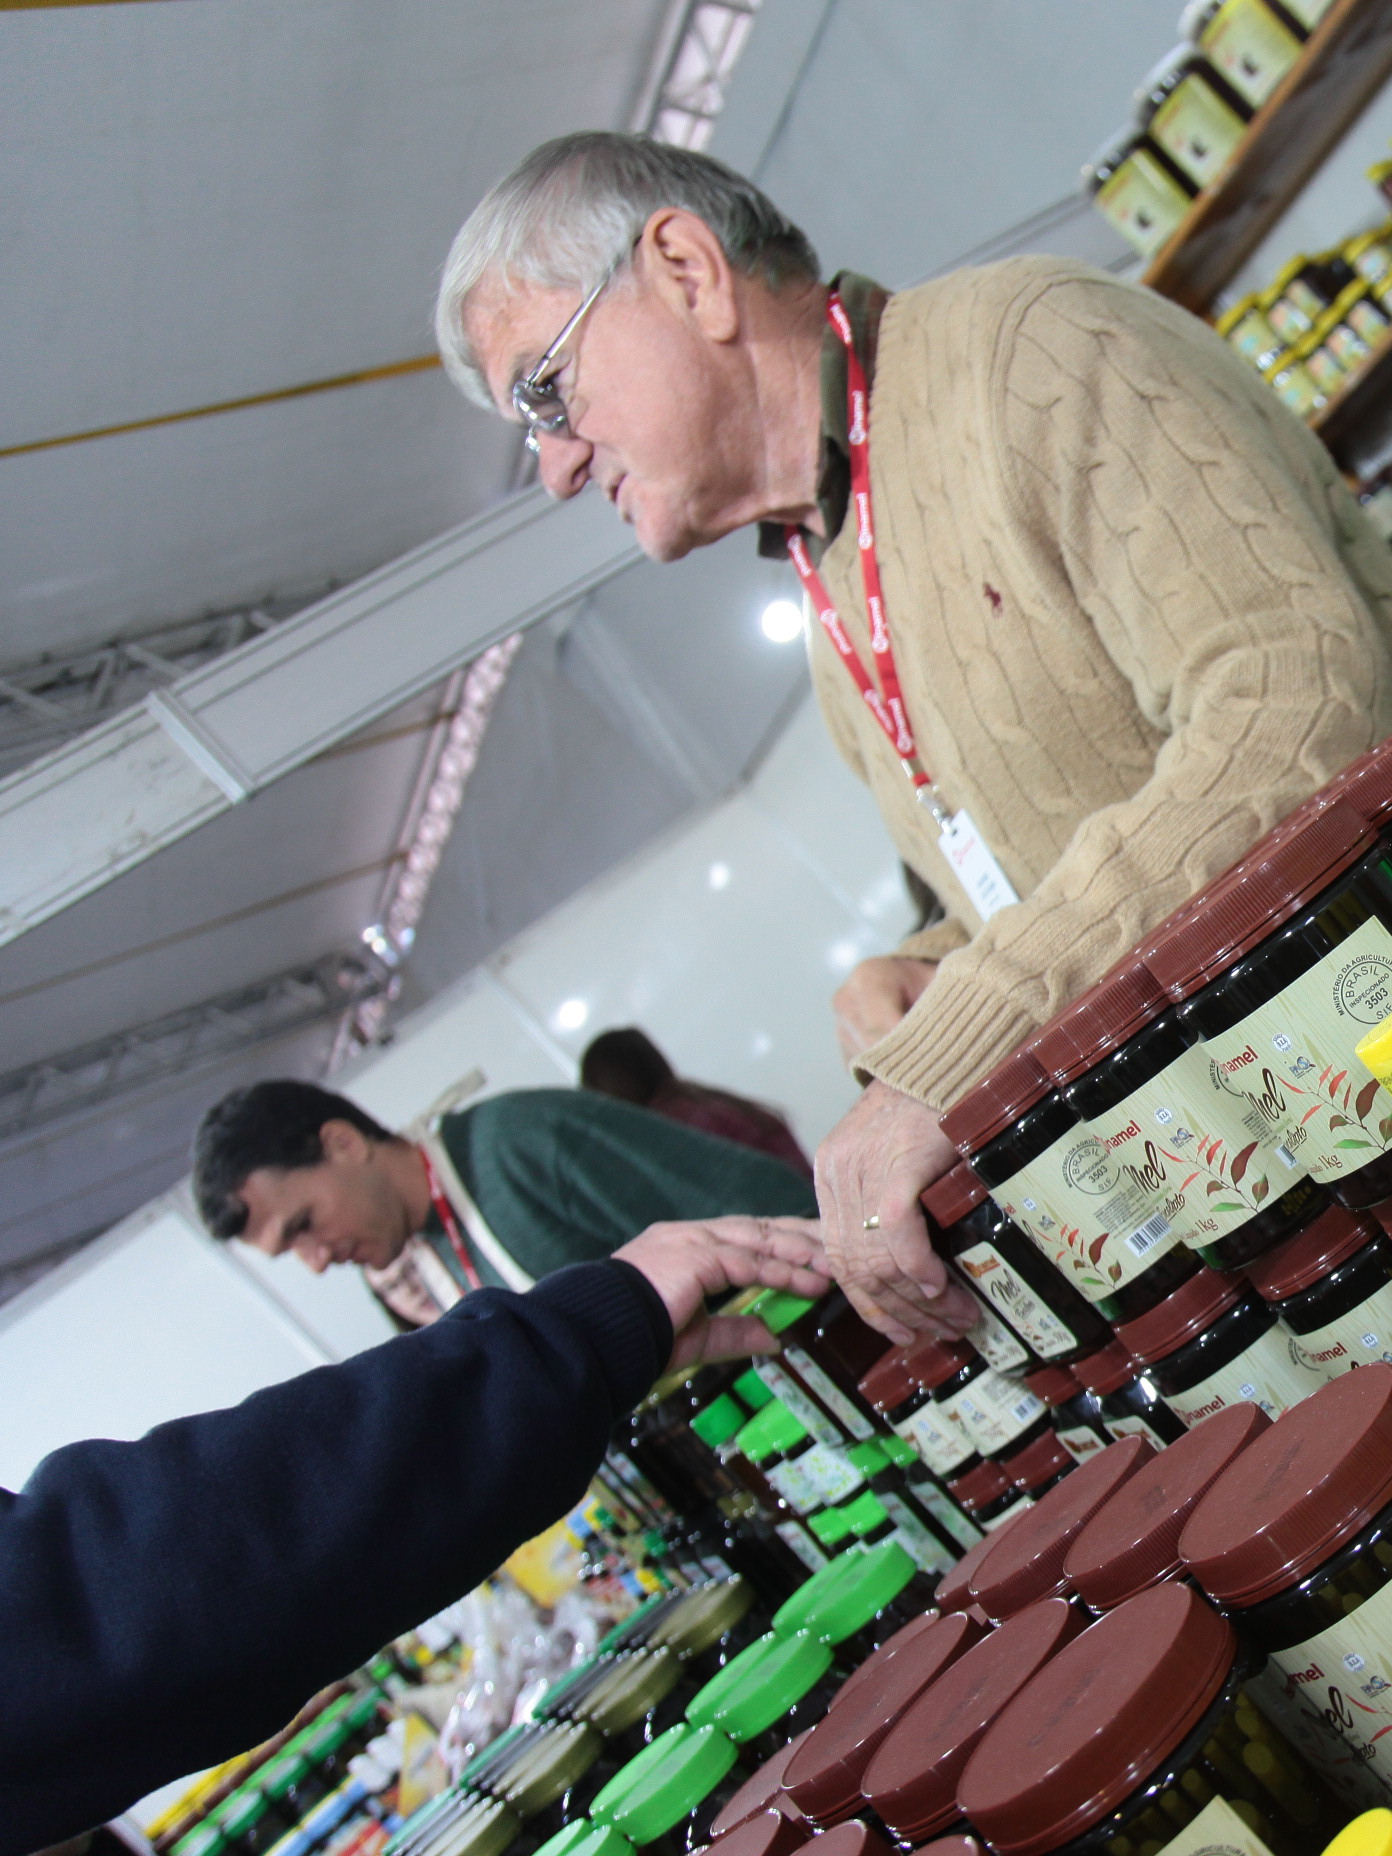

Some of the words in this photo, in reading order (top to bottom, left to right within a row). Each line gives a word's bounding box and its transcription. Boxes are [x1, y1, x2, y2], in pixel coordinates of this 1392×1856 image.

[1333, 973, 1345, 1016] MINISTÉRIO
[1345, 965, 1380, 998] BRASIL
[1349, 972, 1390, 1008] INSPECIONADO
[1364, 987, 1389, 1009] 3503
[1209, 1059, 1221, 1090] MINISTÉR
[1219, 1045, 1259, 1074] namel
[1241, 1068, 1287, 1123] Mel
[1099, 1120, 1142, 1155] namel
[1122, 1140, 1167, 1200] Mel
[1318, 1154, 1343, 1170] 1kg
[1195, 1218, 1219, 1234] 1kg
[1308, 1341, 1348, 1364] namel
